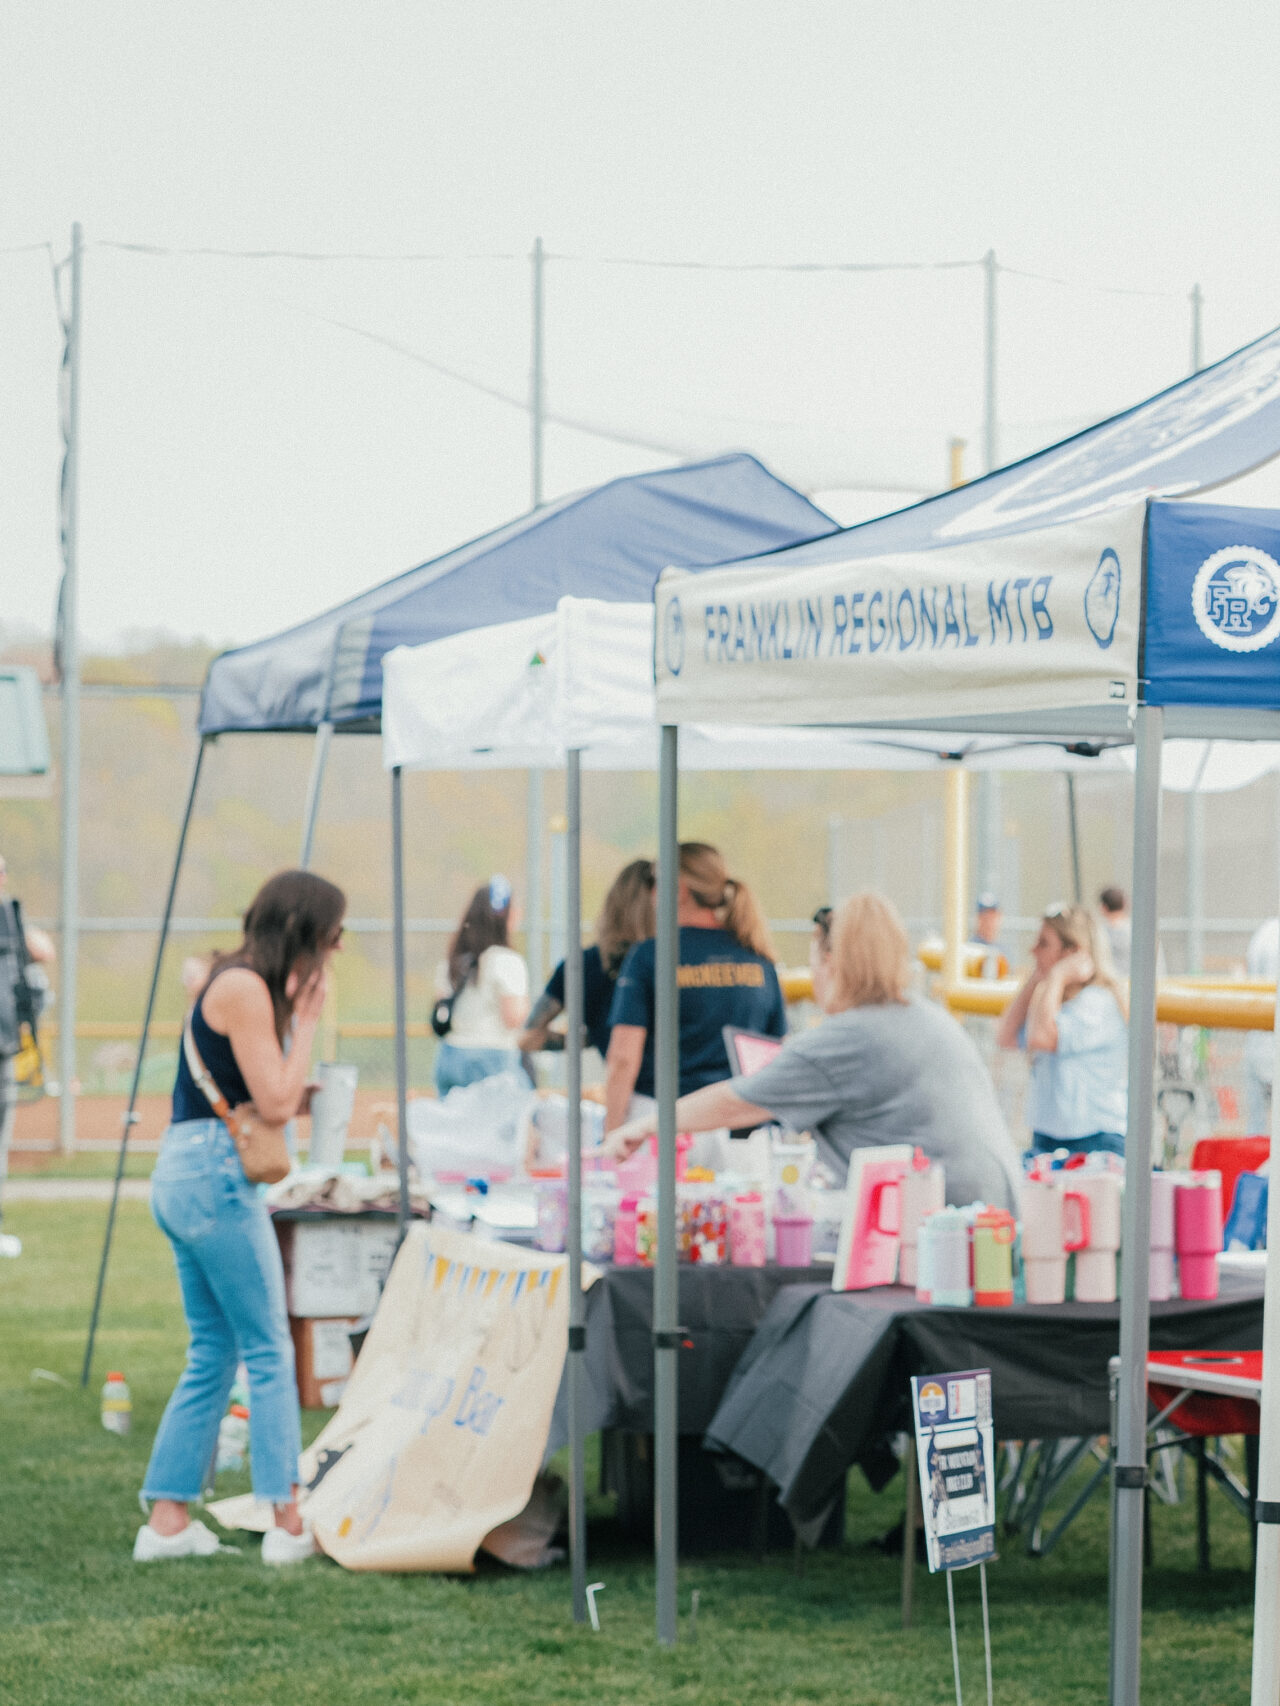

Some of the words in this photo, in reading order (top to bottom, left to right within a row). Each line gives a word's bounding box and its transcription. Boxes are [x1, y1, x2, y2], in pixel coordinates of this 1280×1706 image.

[704, 594, 824, 662] FRANKLIN
[829, 582, 979, 656] REGIONAL
[987, 575, 1054, 645] MTB
